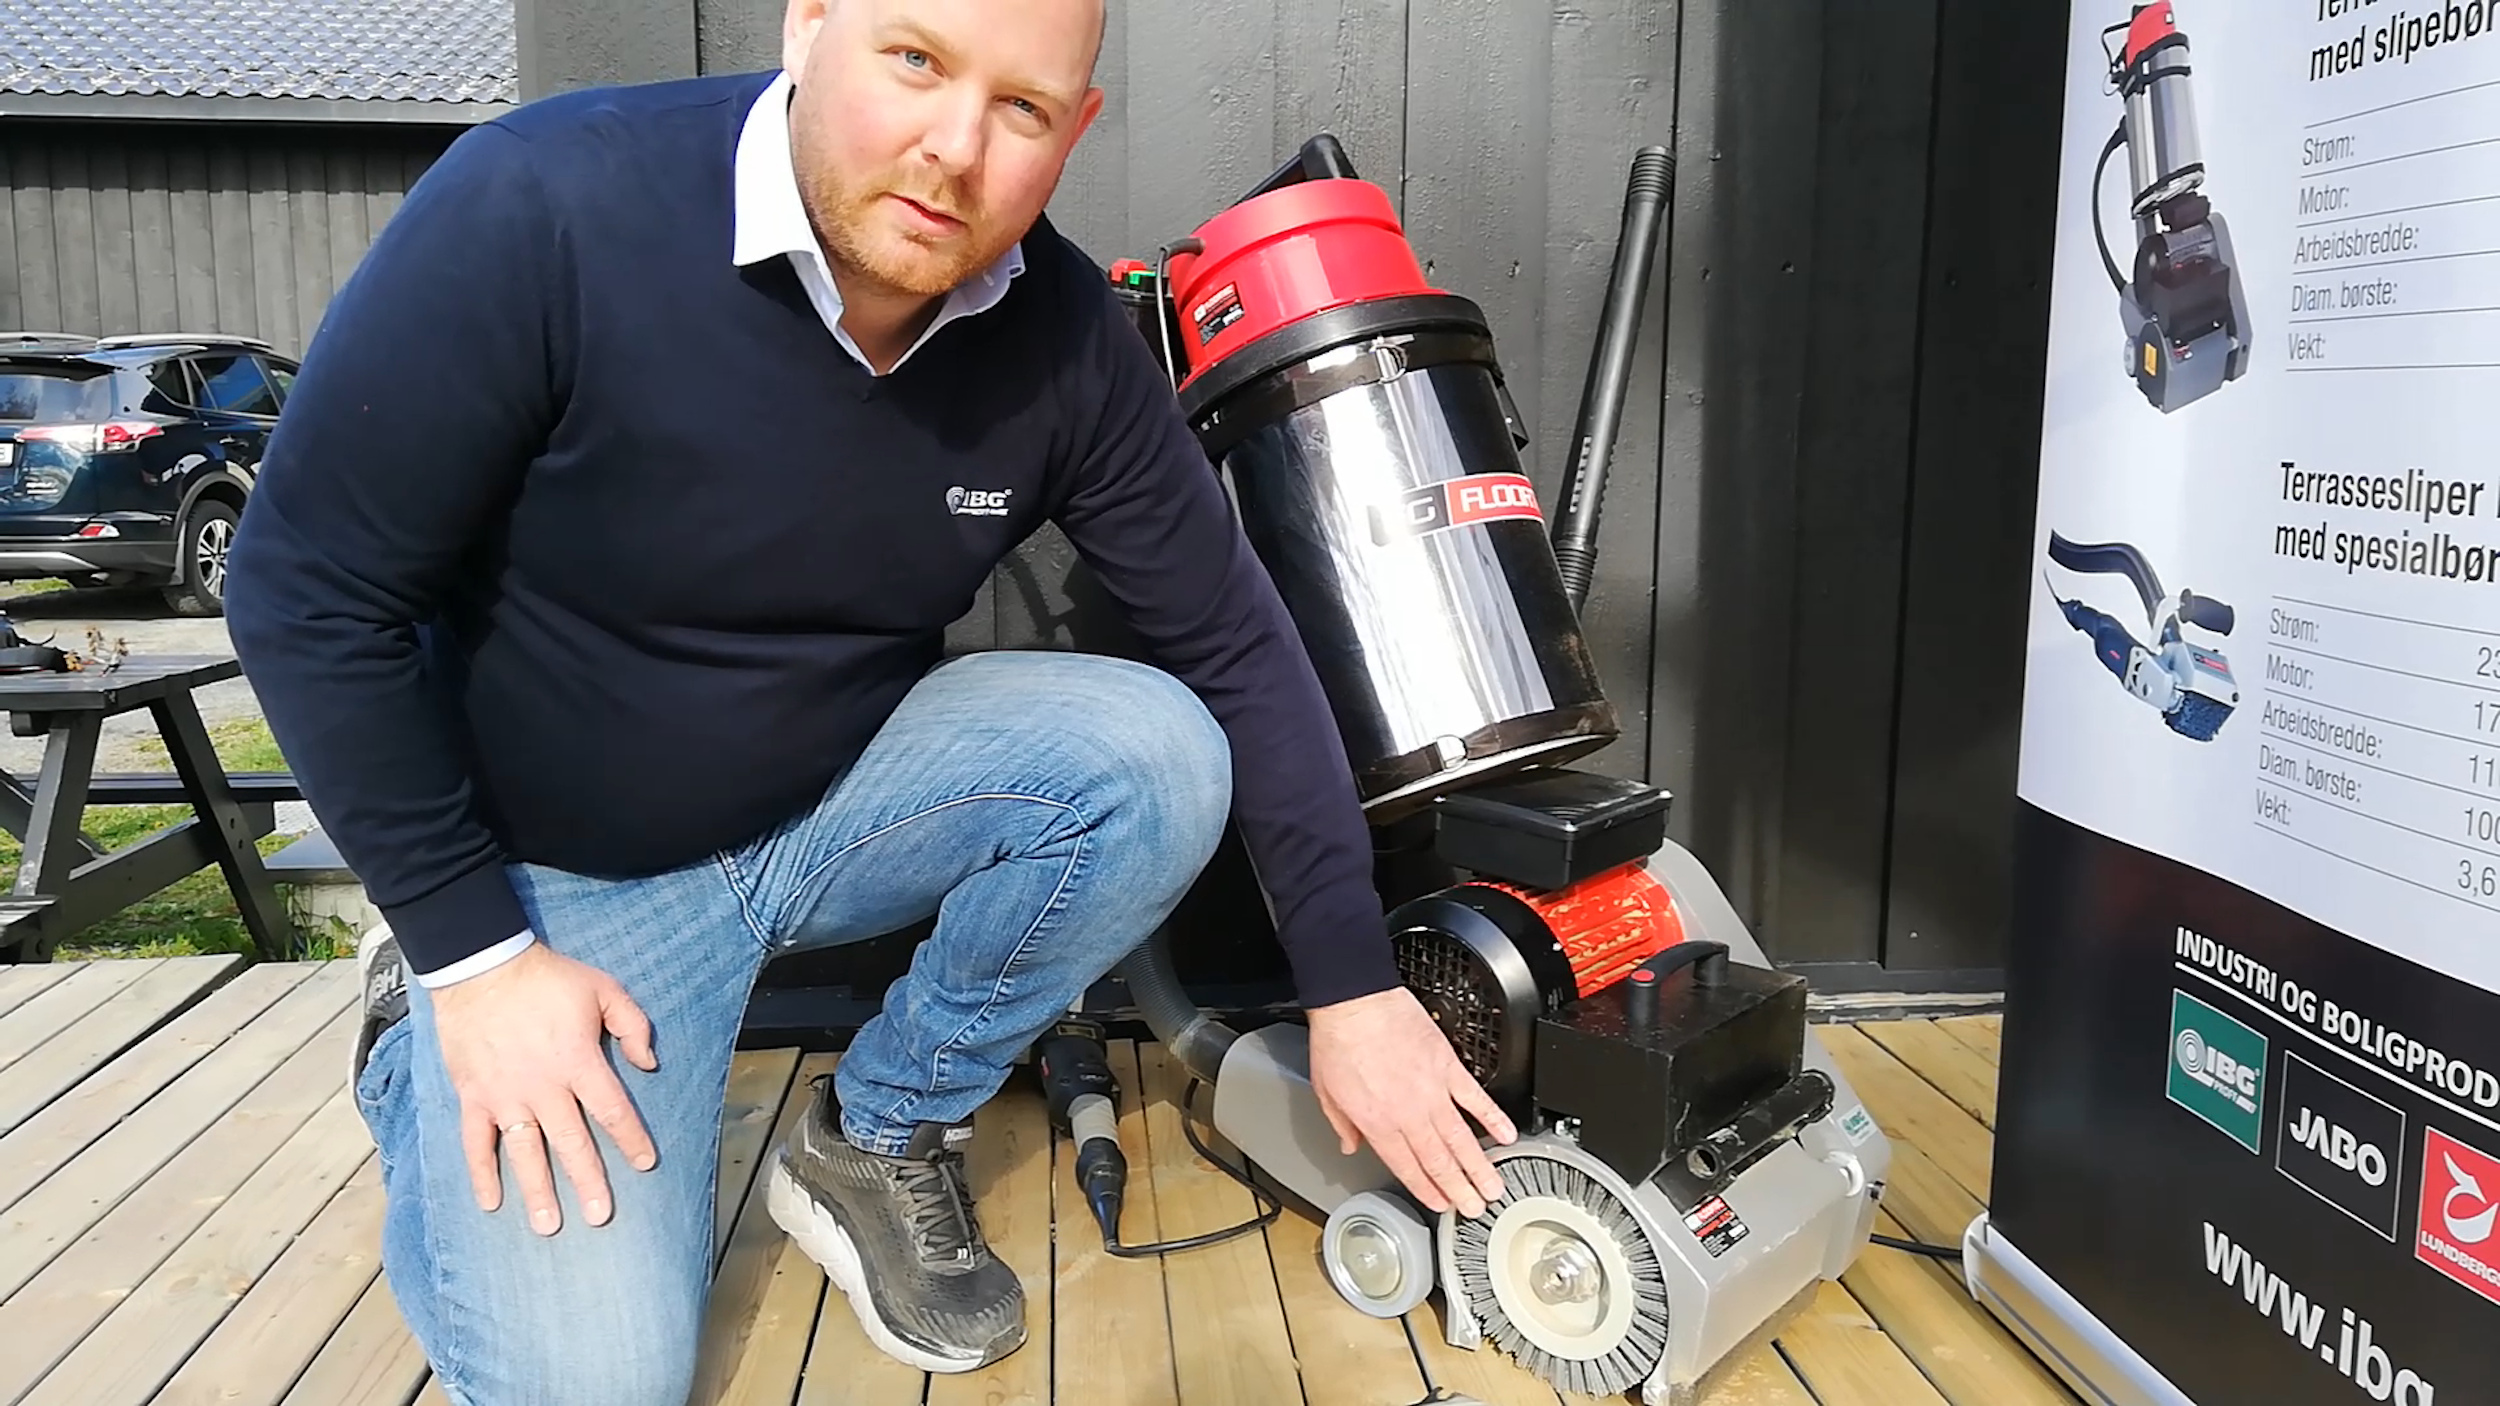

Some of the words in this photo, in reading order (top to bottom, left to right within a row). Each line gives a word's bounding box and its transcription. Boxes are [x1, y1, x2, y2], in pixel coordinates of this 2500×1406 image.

[2310, 25, 2366, 81] med
[2303, 136, 2355, 166] Strøm:
[2299, 186, 2349, 215] Motor:
[2294, 223, 2419, 264] Arbeidsbredde:
[2291, 285, 2336, 312] Diam.
[2341, 278, 2398, 308] børste:
[2288, 333, 2325, 360] Vekt:
[2281, 462, 2485, 523] Terrassesliper
[2275, 522, 2326, 562] med
[2270, 608, 2320, 643] Strøm:
[2266, 654, 2314, 690] Motor:
[2261, 700, 2382, 759] Arbeidsbredde:
[2469, 755, 2500, 788] 11
[2259, 744, 2300, 782] Diam.
[2305, 759, 2361, 802] børste:
[2256, 788, 2291, 826] Vekt:
[2458, 859, 2497, 897] 3,6
[2175, 926, 2277, 1002] INDUSTRI
[2280, 980, 2317, 1023] OG
[2321, 1000, 2500, 1108] BOLIGPROD
[2206, 1045, 2256, 1097] IBG
[2289, 1106, 2388, 1187] JABO
